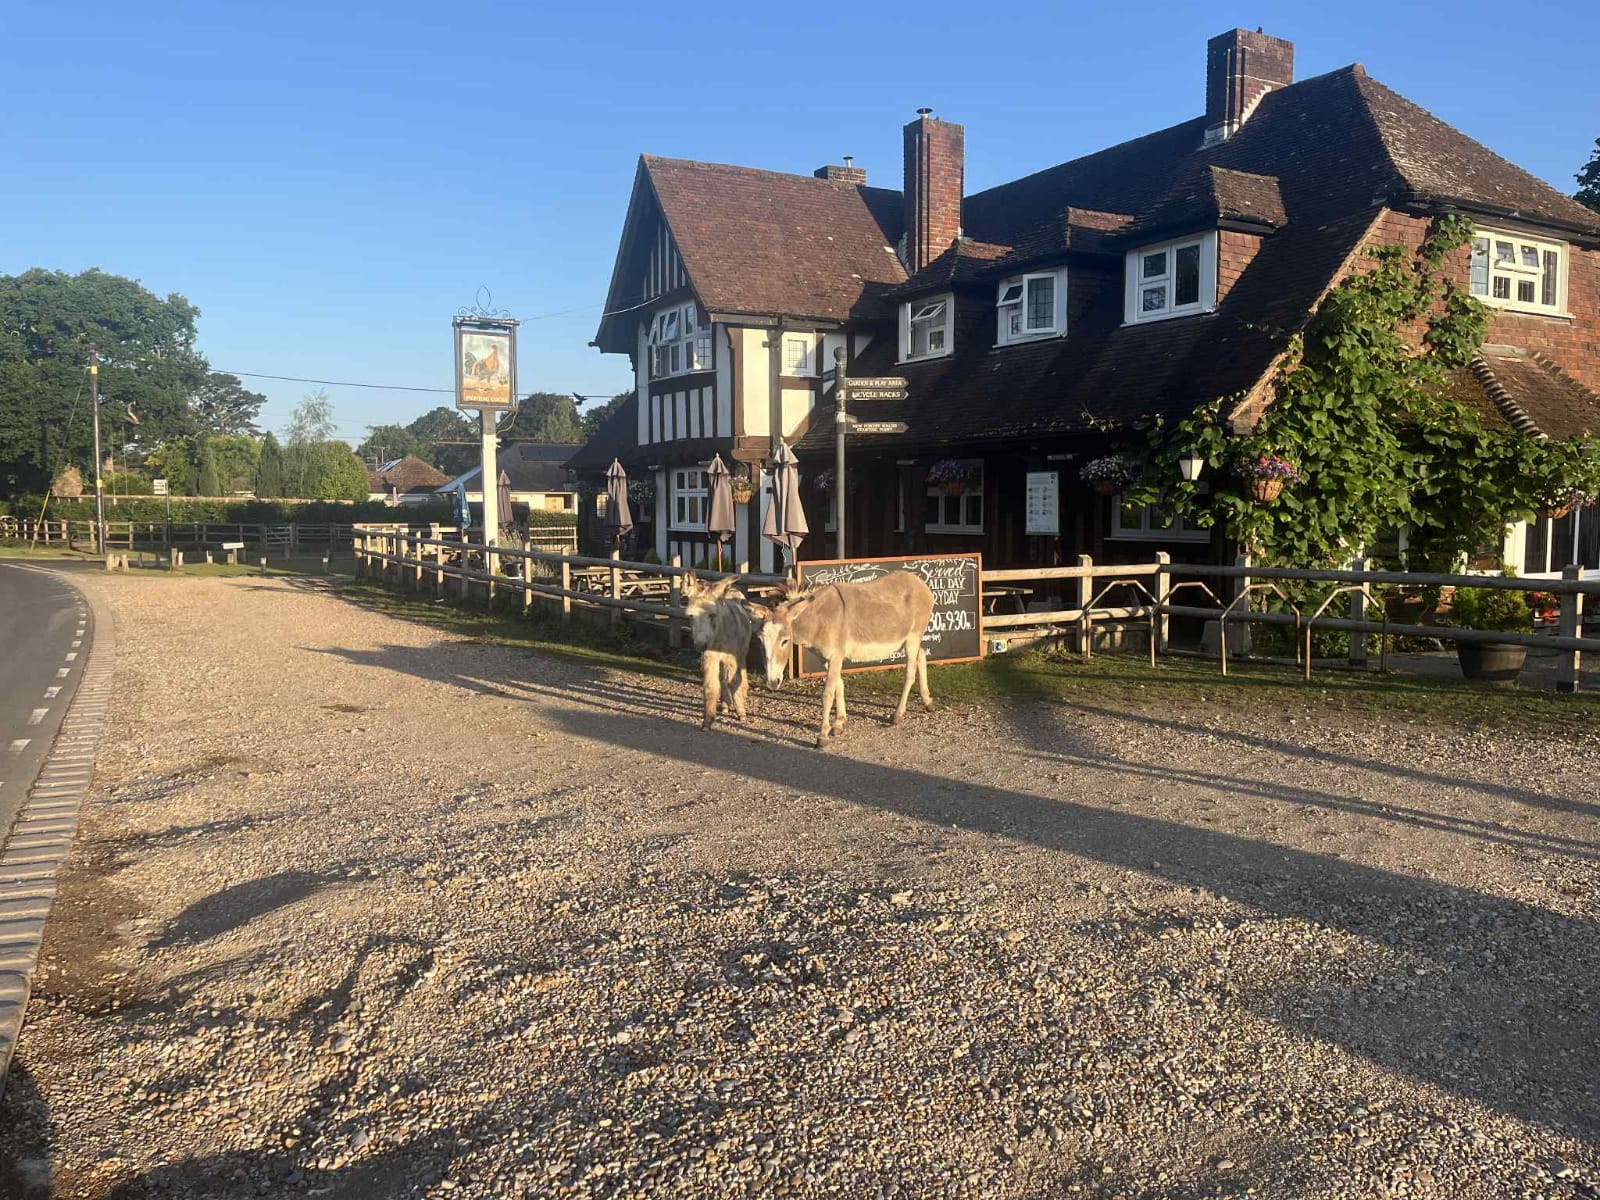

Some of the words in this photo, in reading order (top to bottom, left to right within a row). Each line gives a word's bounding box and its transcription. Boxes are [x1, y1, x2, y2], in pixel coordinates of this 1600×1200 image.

[921, 560, 966, 583] Served
[929, 578, 945, 589] ALL
[948, 577, 966, 589] DAY
[932, 590, 960, 605] RYDAY
